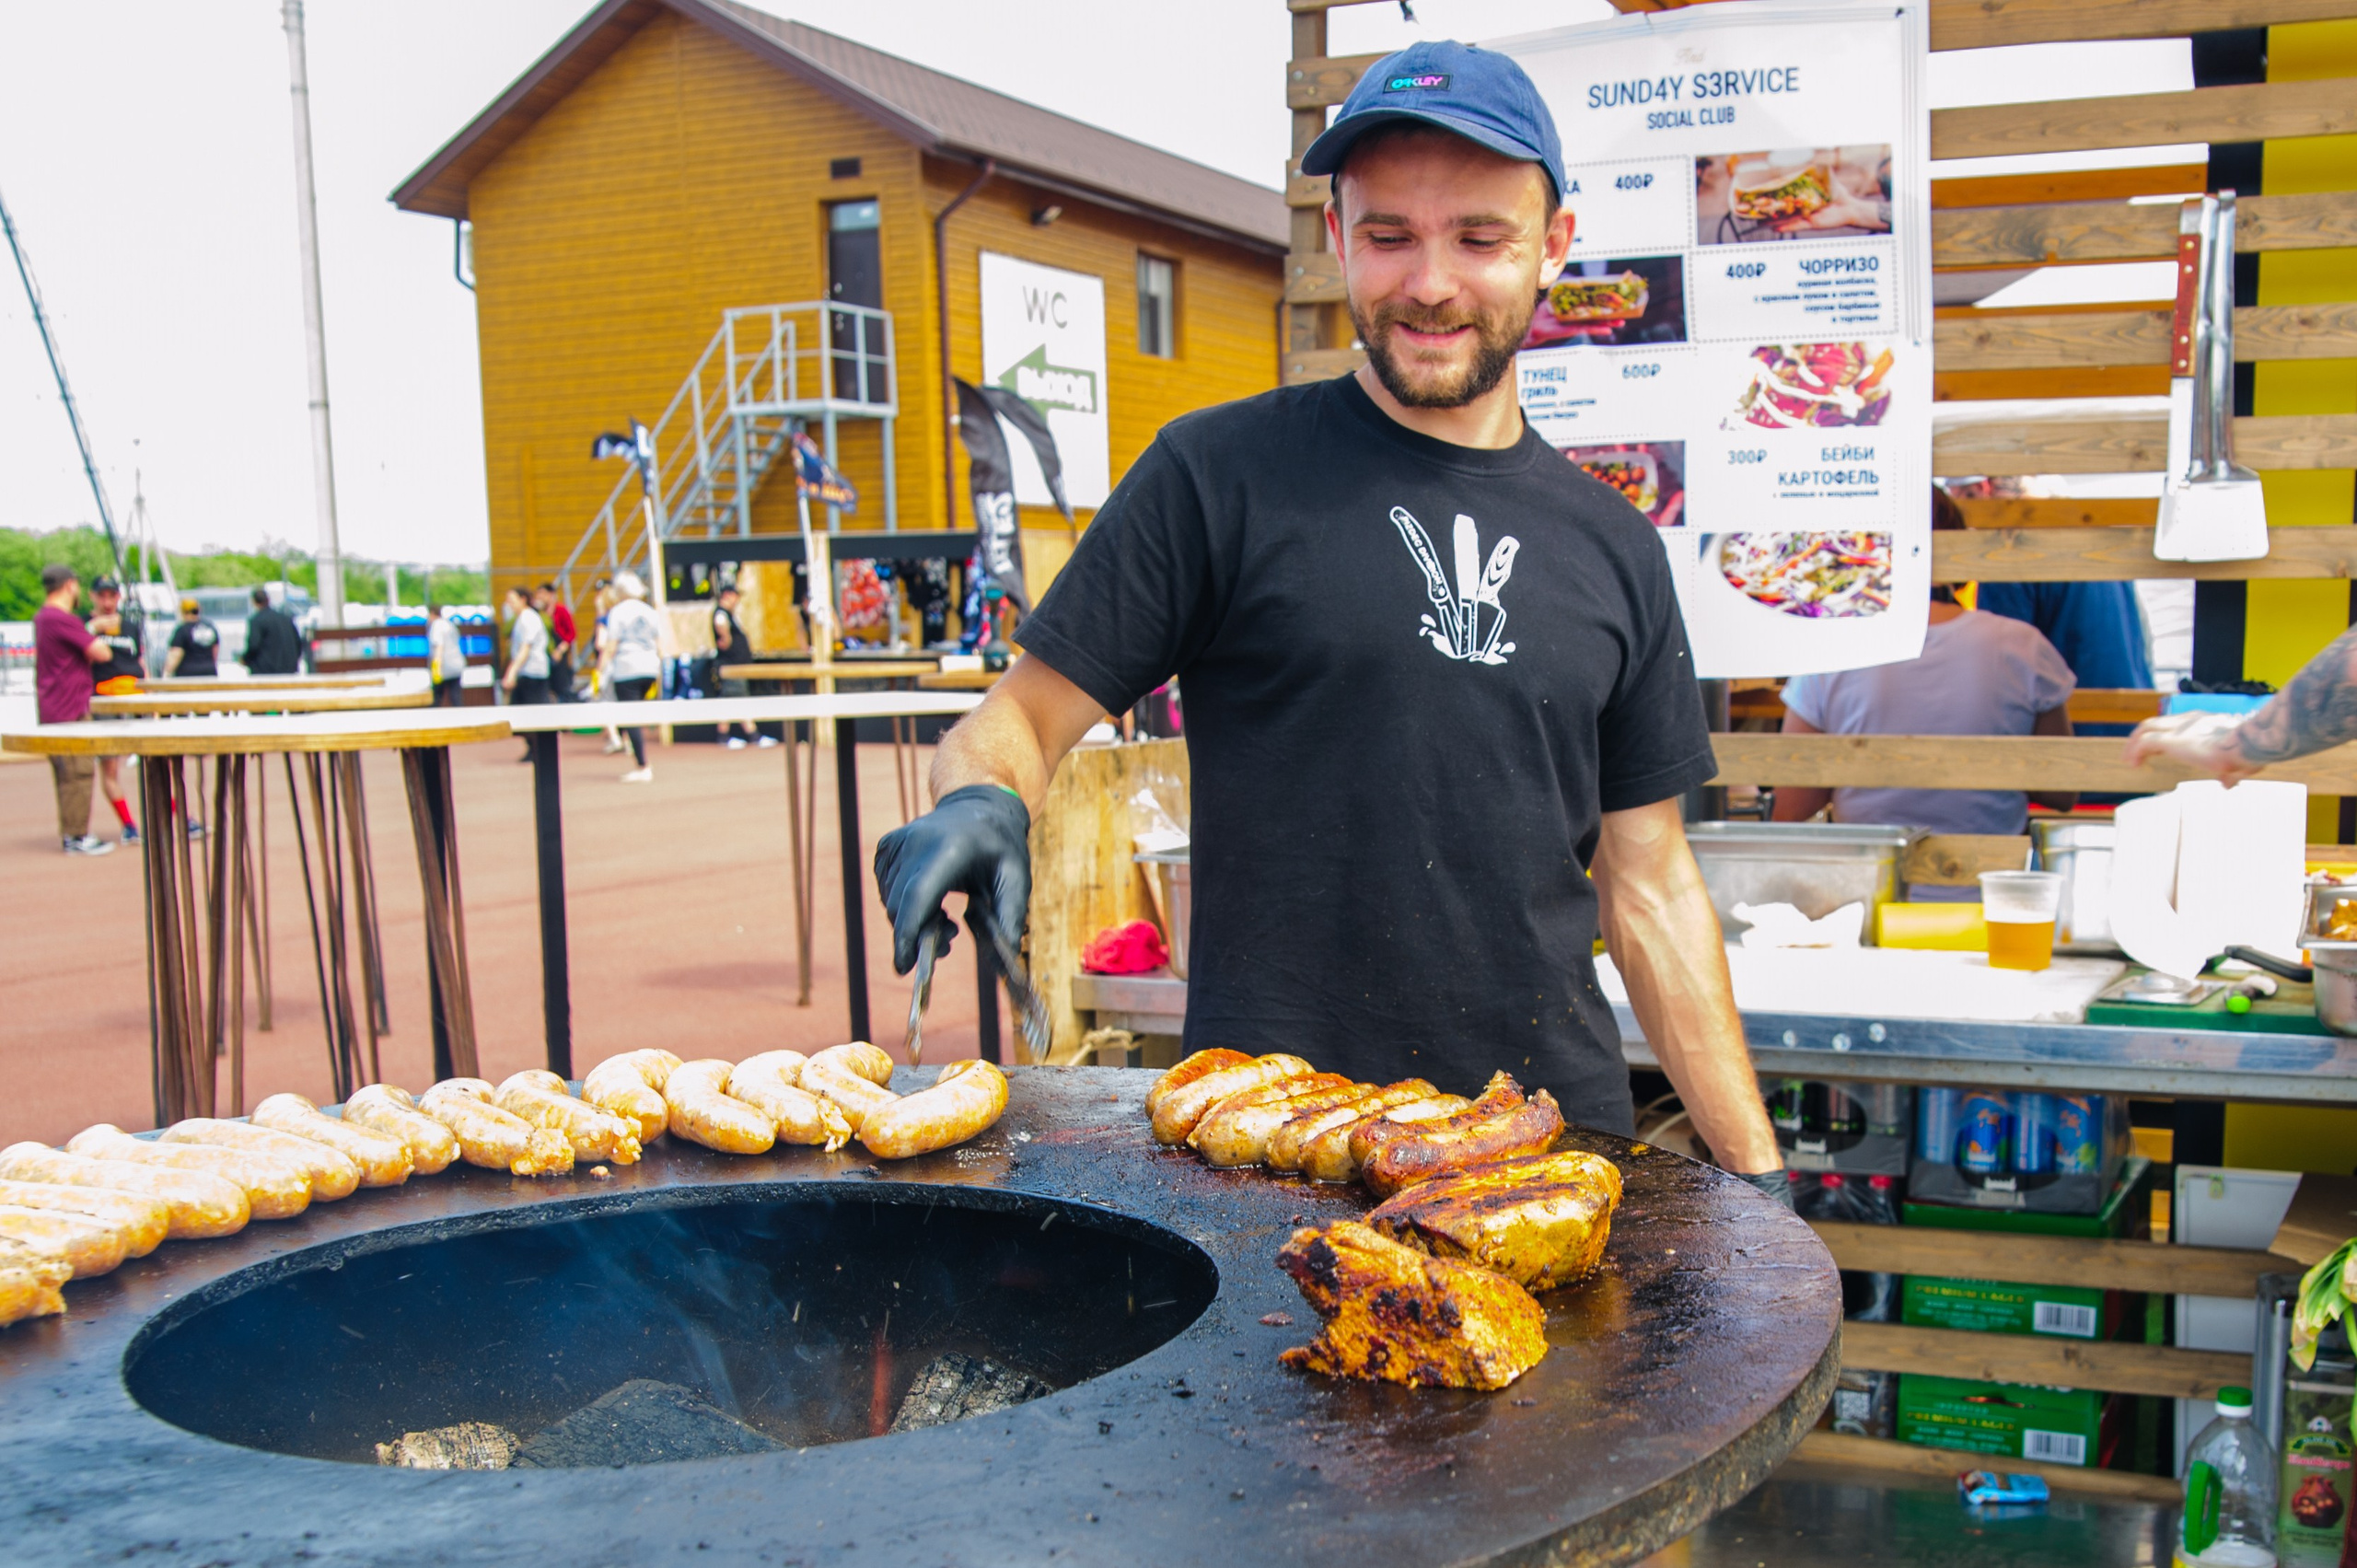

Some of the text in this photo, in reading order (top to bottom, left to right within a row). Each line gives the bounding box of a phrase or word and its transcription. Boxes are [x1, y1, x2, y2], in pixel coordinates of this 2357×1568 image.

[1391, 75, 1444, 89] OAKLEY
[1588, 66, 1800, 109] SUND4Y S3RVICE
[1647, 106, 1736, 130] SOCIAL CLUB
[1798, 256, 1880, 274] ЧОРРИЗО
[1022, 285, 1069, 330] WC
[1523, 366, 1568, 384] ТУНЕЦ
[1820, 444, 1875, 462] БЕЙБИ
[1777, 469, 1880, 486] КАРТОФЕЛЬ
